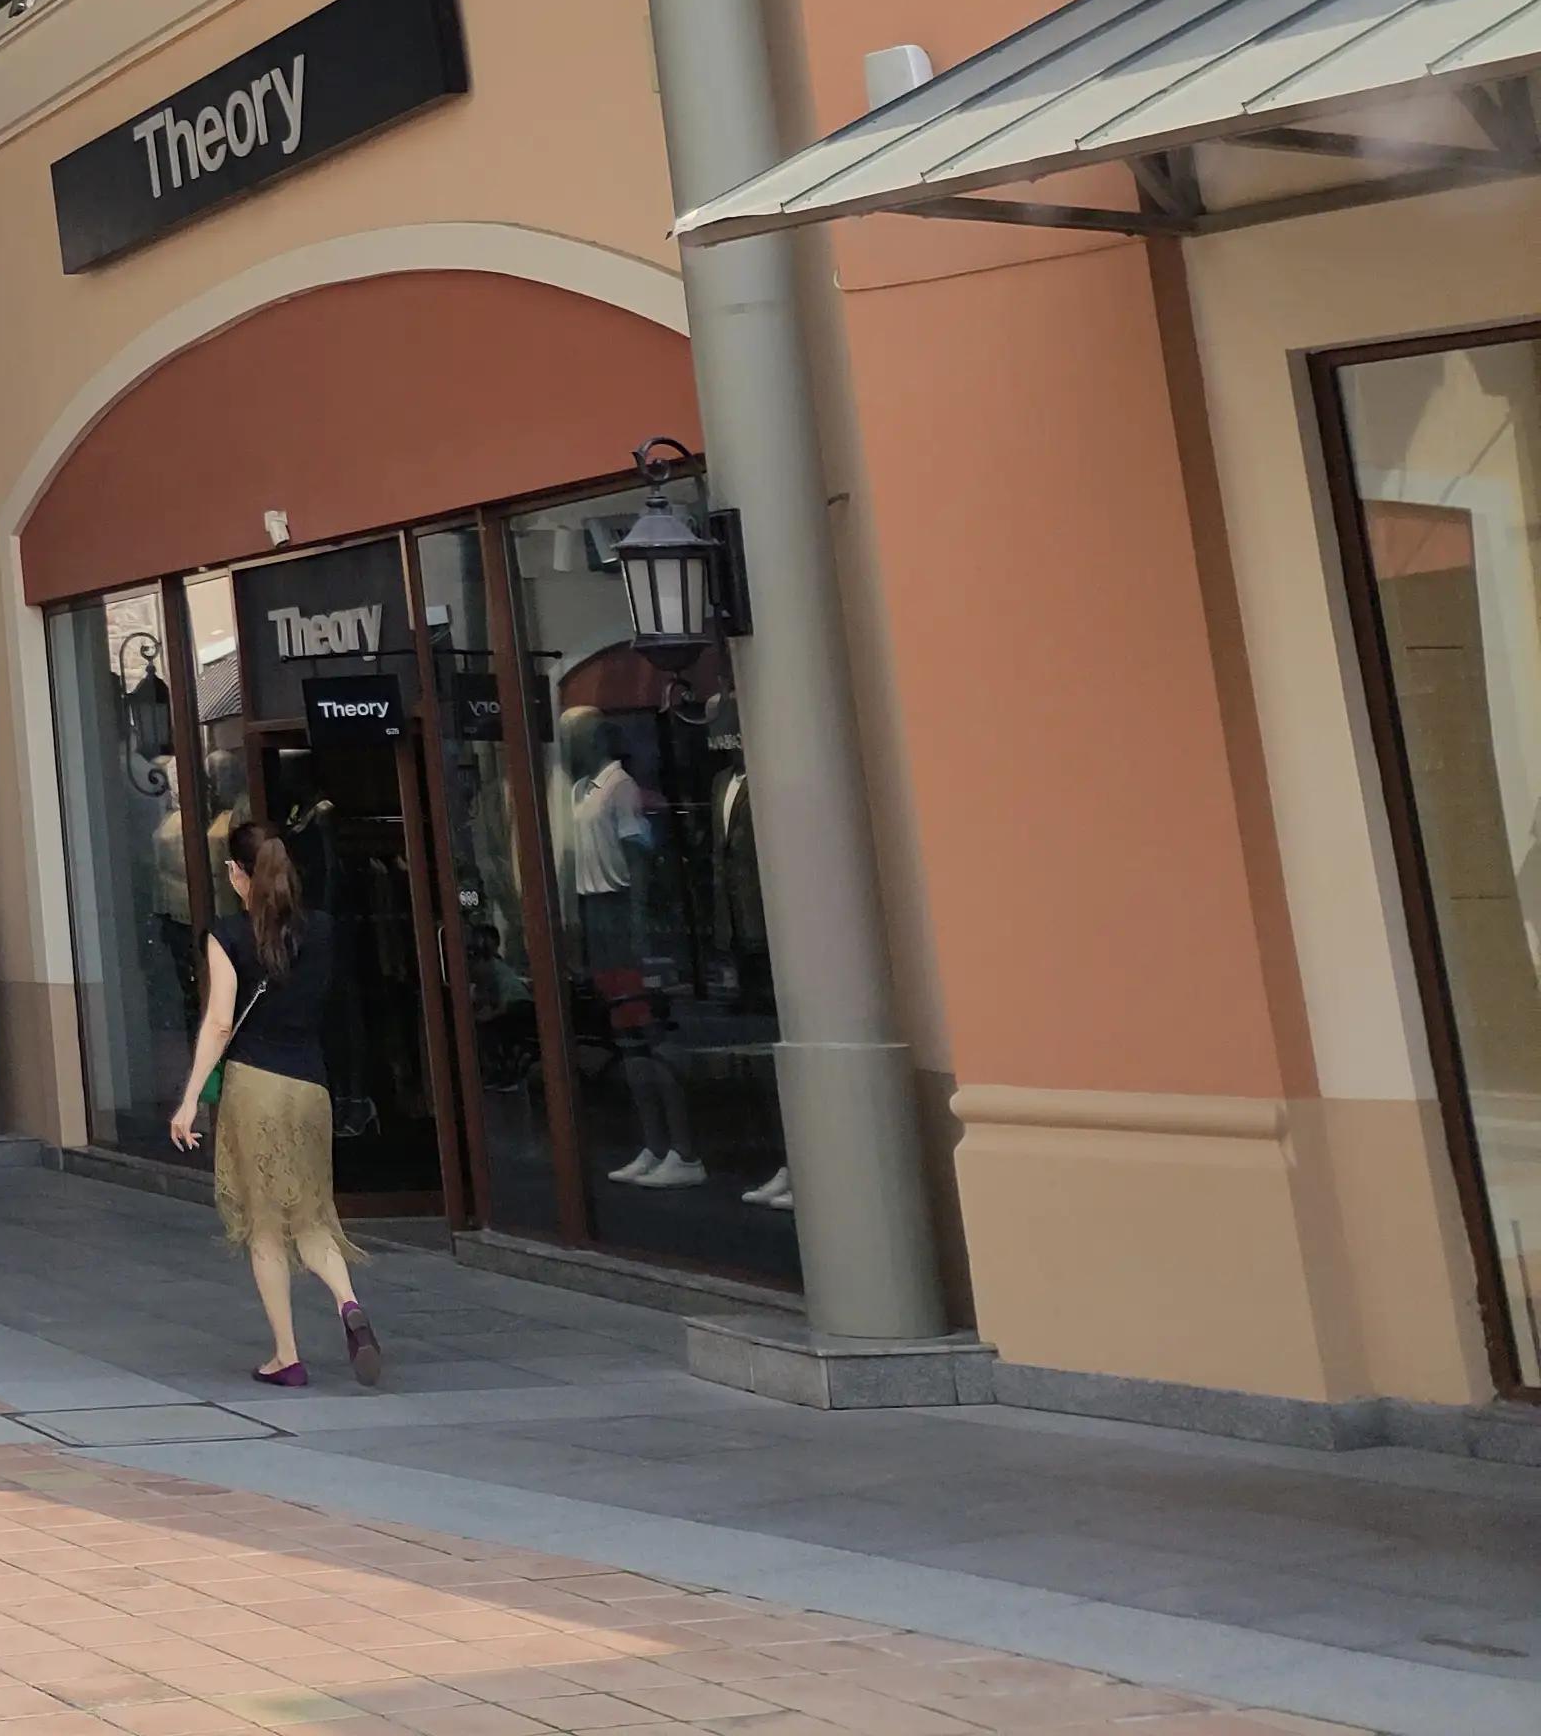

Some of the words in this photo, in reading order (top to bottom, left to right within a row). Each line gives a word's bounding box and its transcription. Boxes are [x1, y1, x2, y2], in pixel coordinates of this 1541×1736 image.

[133, 53, 305, 198] Theory
[267, 603, 383, 662] Theory
[317, 701, 389, 719] Theory
